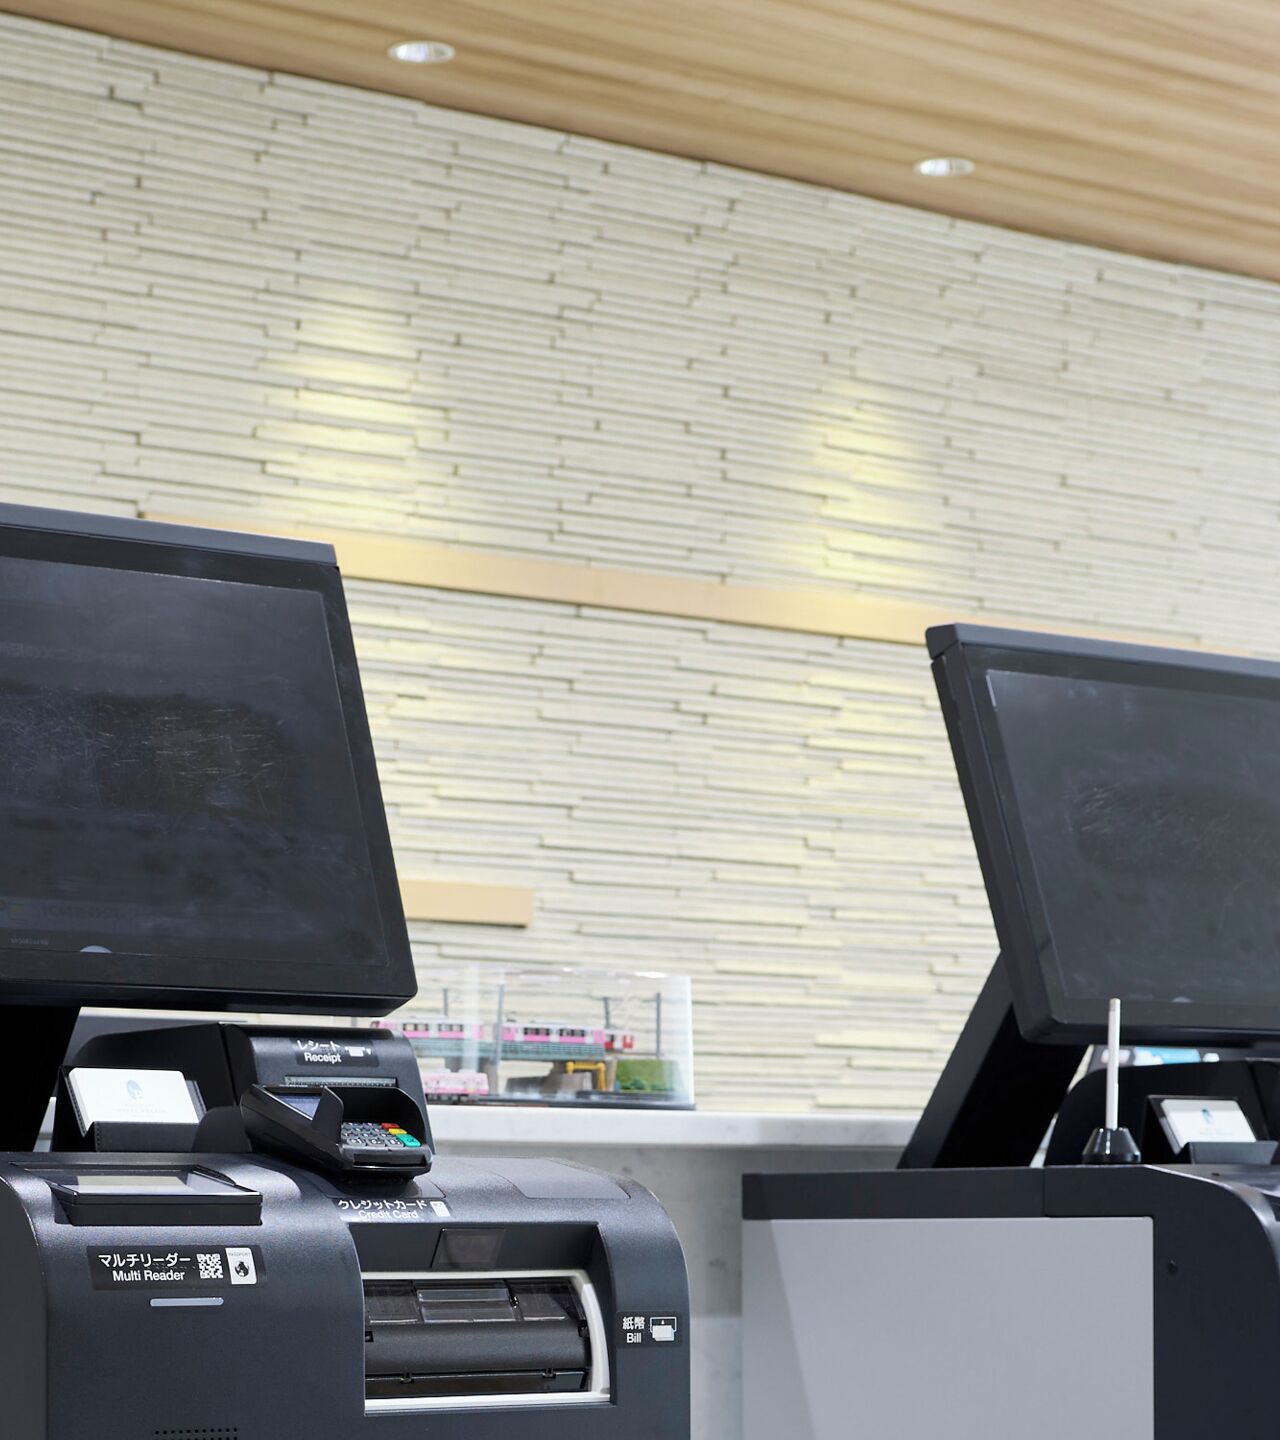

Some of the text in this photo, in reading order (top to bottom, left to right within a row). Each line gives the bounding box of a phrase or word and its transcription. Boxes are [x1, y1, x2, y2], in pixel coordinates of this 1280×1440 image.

[296, 1040, 340, 1051] レシート
[304, 1052, 342, 1064] Receipt
[338, 1199, 427, 1210] クレジットカード
[358, 1210, 418, 1219] Credit Card
[98, 1253, 191, 1268] マルチリーダー
[112, 1270, 185, 1281] Multi Reader
[626, 1332, 642, 1344] Bill
